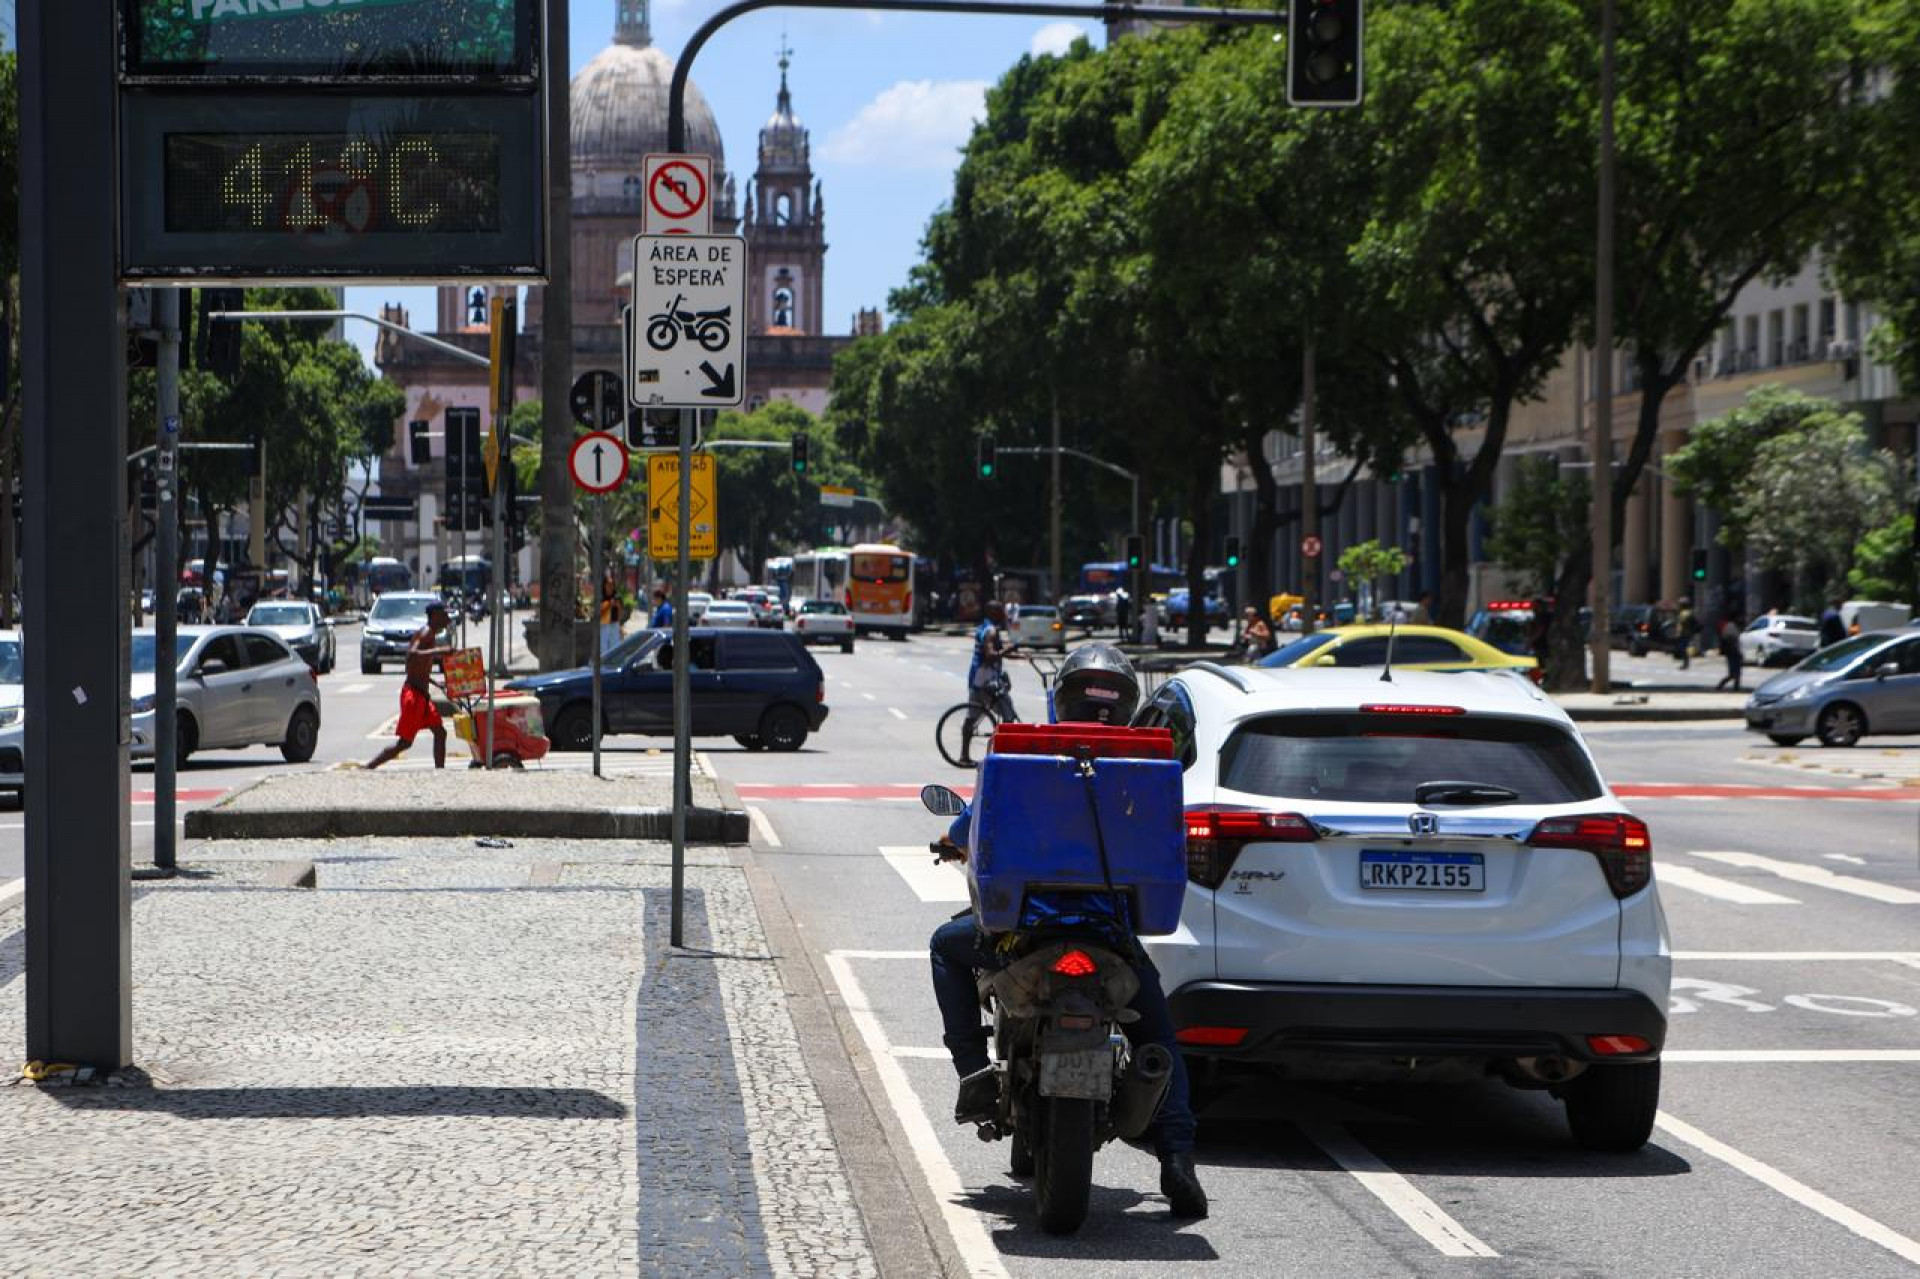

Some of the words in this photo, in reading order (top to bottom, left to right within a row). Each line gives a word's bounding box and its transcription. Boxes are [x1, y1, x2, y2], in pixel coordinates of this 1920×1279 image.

[650, 240, 699, 261] ÁREA
[708, 245, 732, 262] DE
[654, 268, 724, 286] ESPERA
